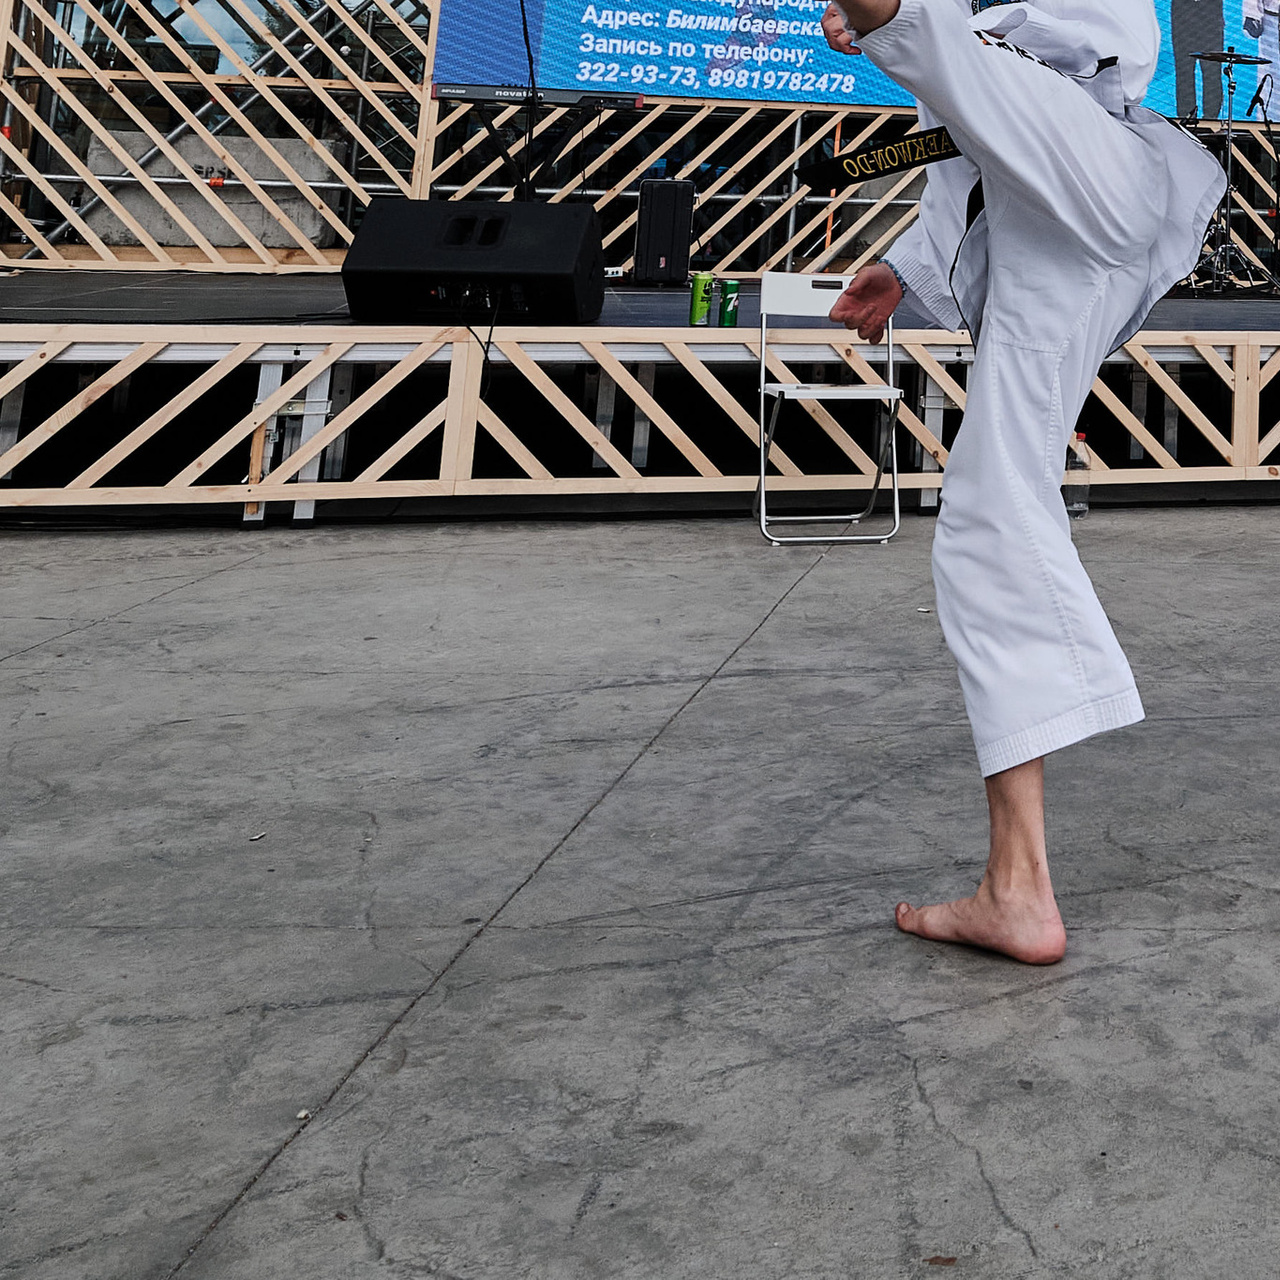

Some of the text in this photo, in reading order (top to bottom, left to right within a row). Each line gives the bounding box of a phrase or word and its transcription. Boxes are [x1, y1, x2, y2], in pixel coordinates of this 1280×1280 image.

[581, 5, 660, 29] Адрес:
[579, 33, 815, 68] Запись по телефону:
[576, 61, 856, 93] 322-93-73, 89819782478
